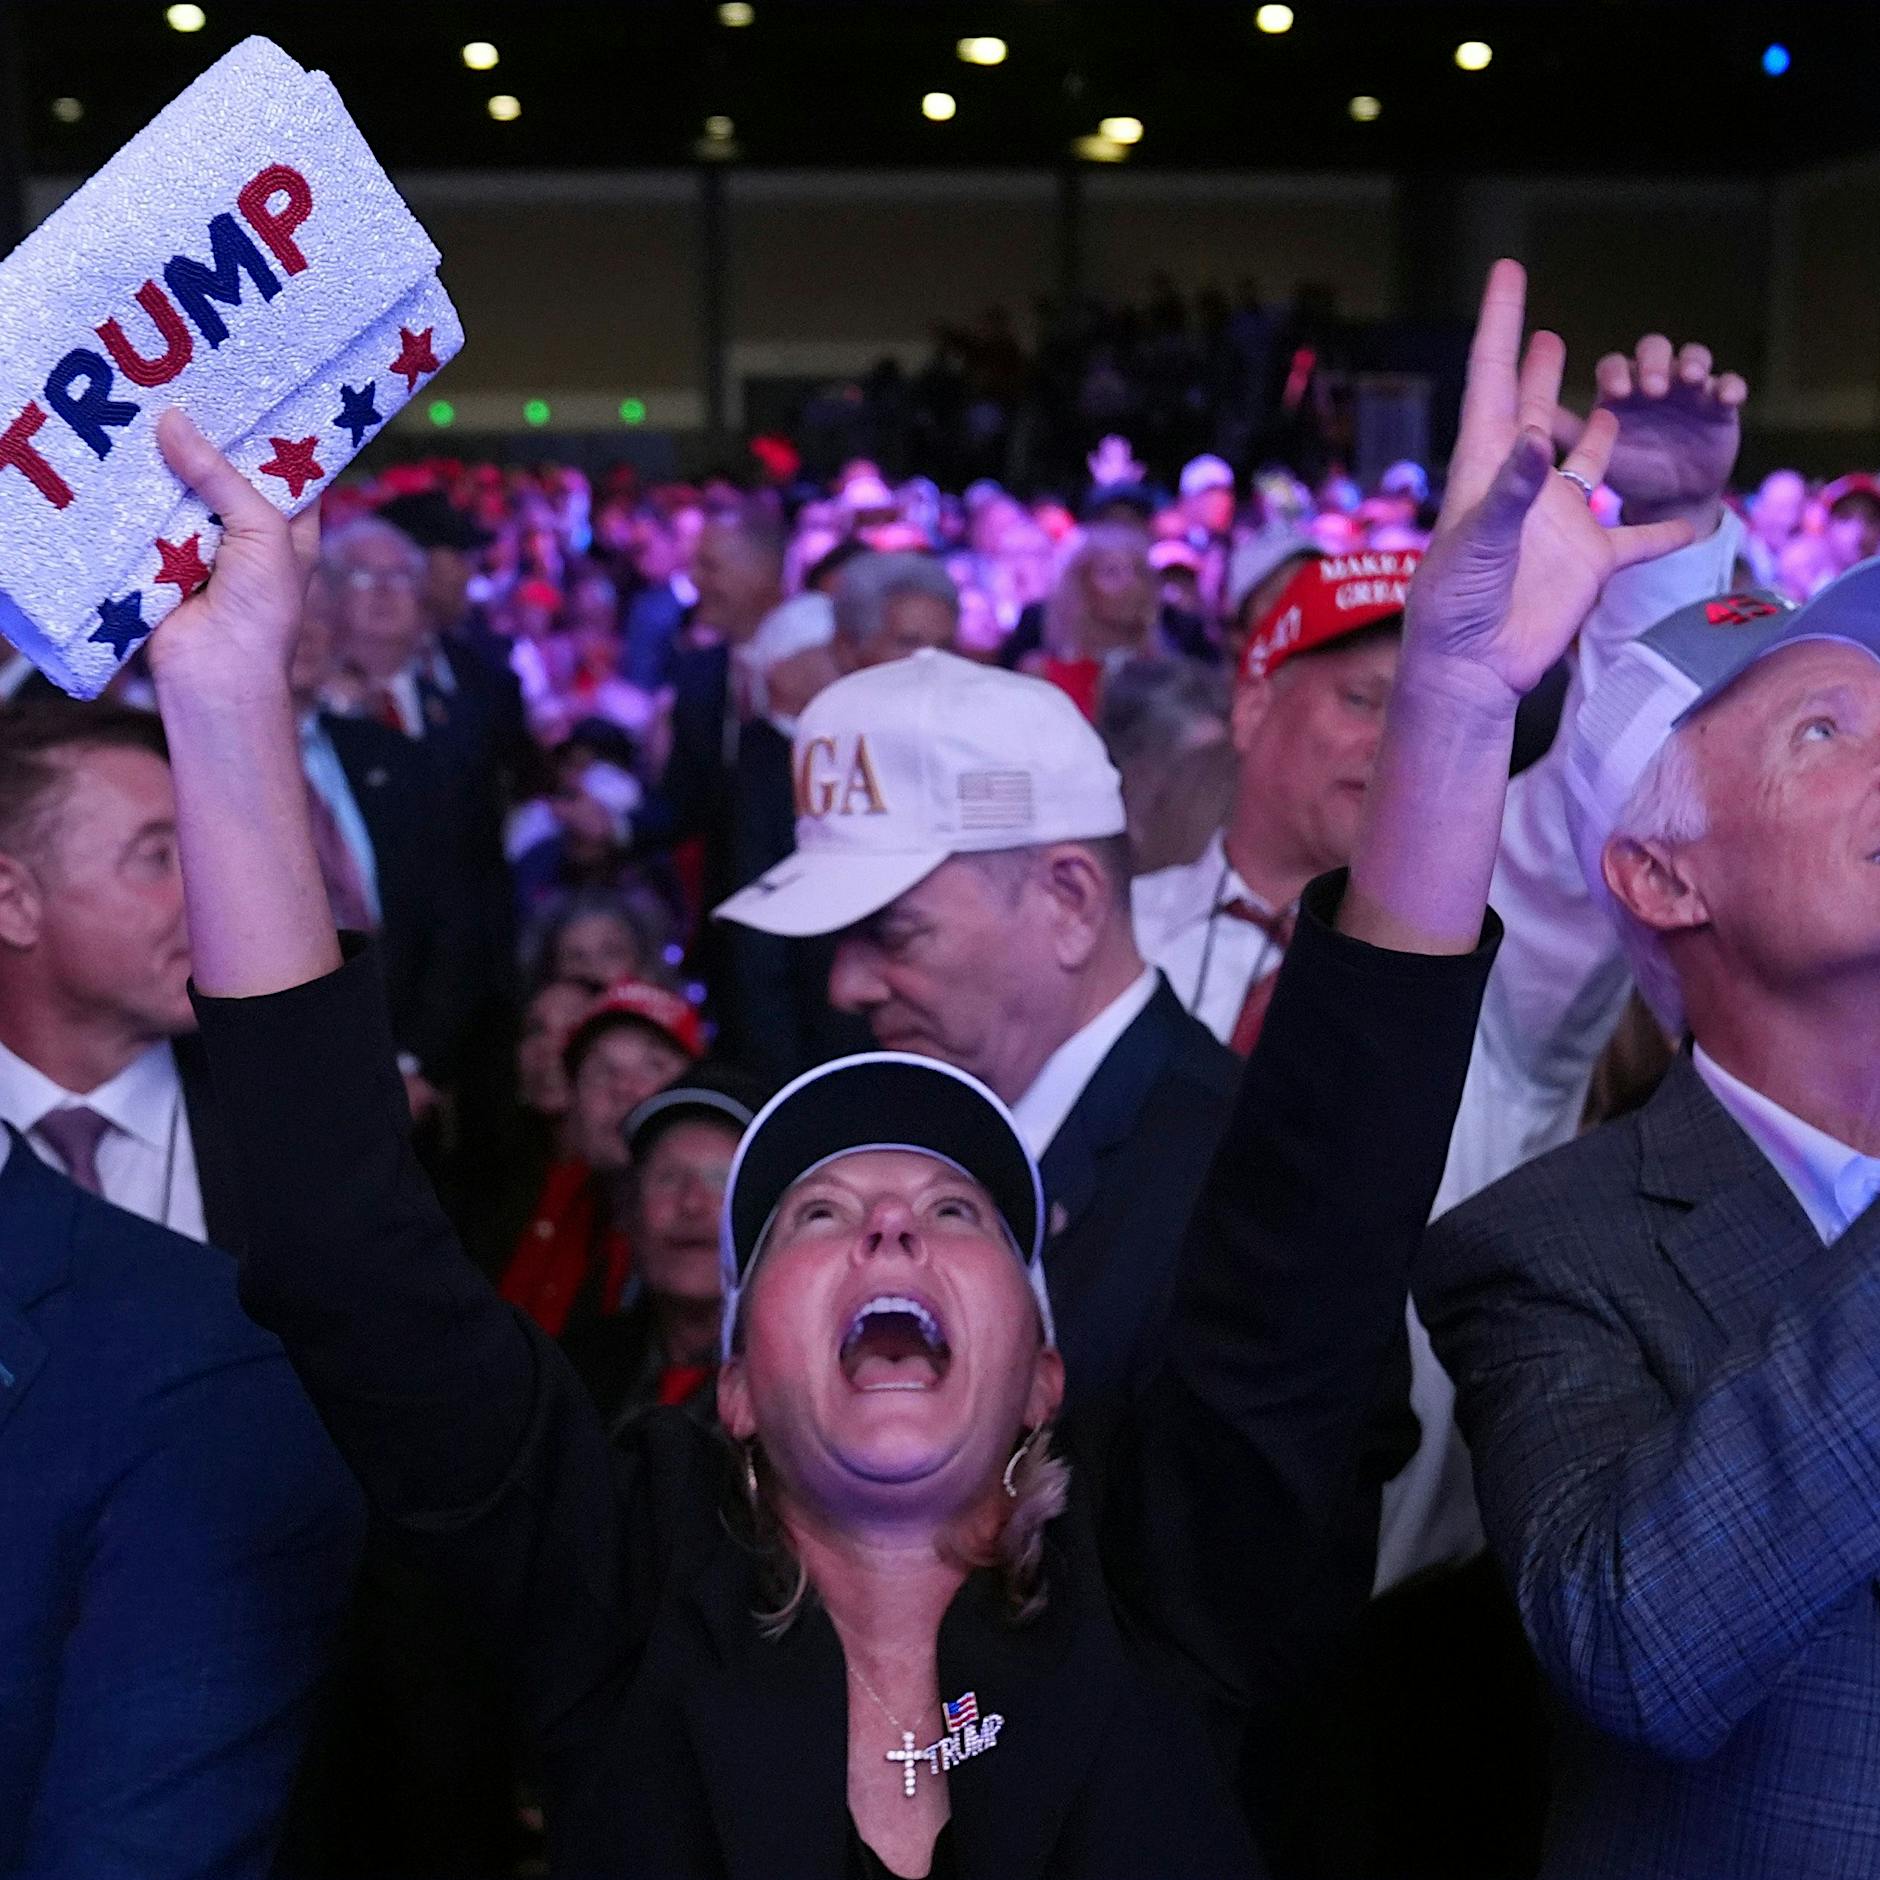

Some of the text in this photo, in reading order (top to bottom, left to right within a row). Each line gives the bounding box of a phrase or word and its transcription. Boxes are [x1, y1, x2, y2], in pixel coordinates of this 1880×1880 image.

[0, 163, 313, 510] TRUMP
[1320, 552, 1398, 583] MAKE
[1335, 580, 1406, 610] GREA
[791, 734, 888, 818] GA
[922, 1713, 1005, 1775] TRUMP
